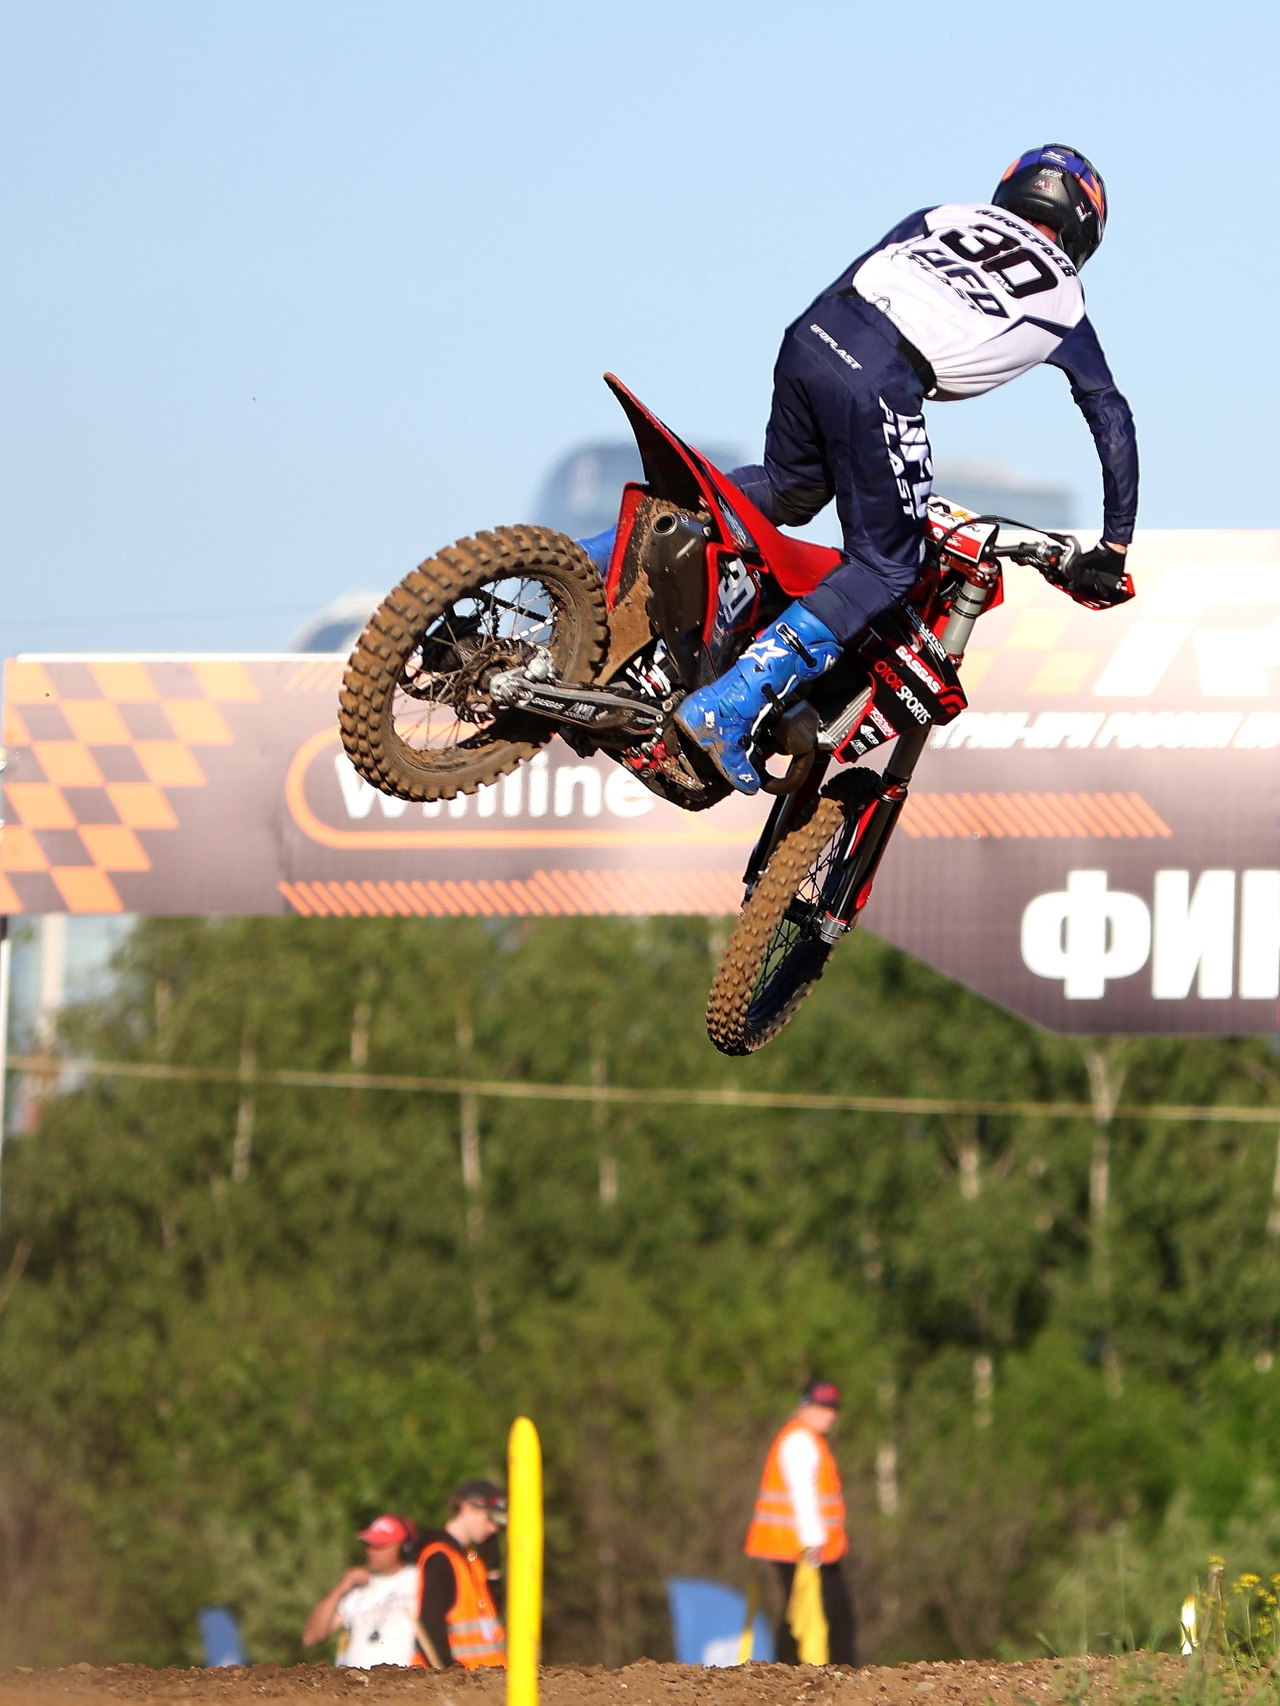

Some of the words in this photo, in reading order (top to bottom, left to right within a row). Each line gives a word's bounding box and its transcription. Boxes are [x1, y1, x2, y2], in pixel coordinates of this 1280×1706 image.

[910, 248, 1011, 318] UFO
[938, 222, 1059, 299] 30
[809, 323, 863, 371] UFOPLAST
[879, 396, 916, 520] PLAST
[873, 660, 932, 725] OTORSPORTS
[895, 645, 941, 694] GASGAS
[333, 750, 655, 819] Wnline
